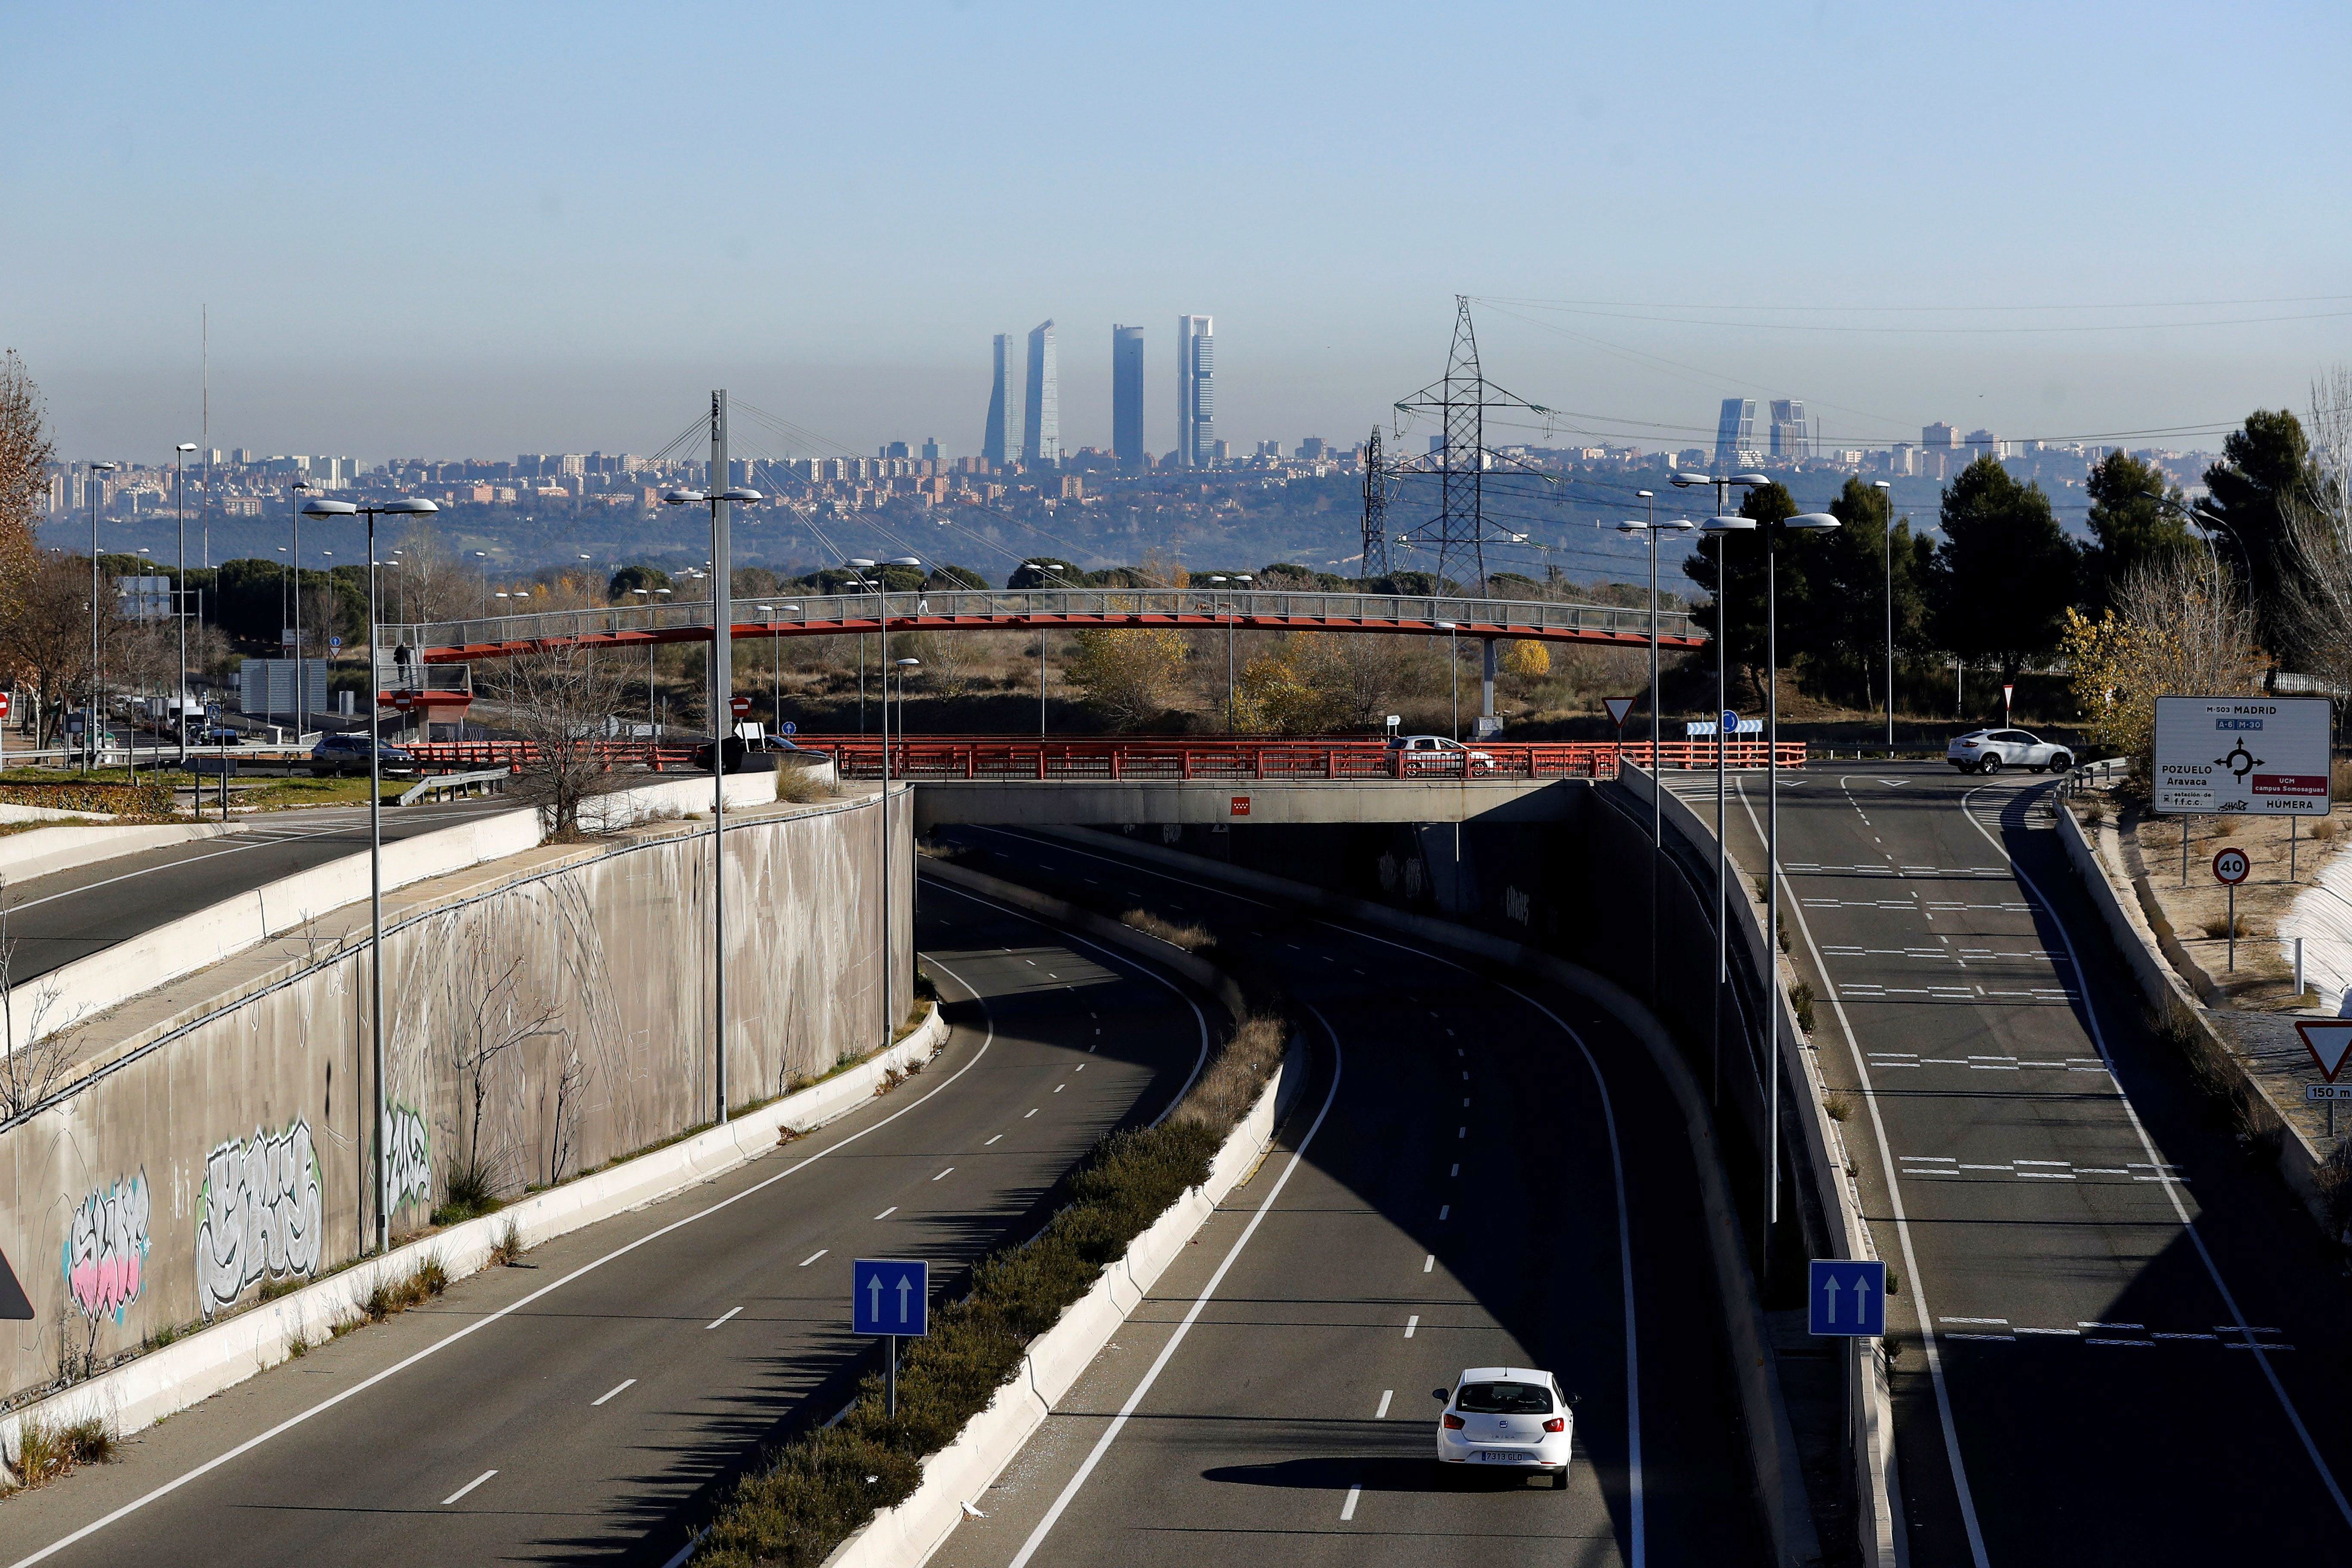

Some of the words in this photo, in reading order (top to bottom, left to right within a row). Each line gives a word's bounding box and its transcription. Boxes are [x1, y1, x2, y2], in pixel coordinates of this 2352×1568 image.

[2234, 706, 2277, 714] MADRID
[2162, 765, 2212, 774] POZUELO
[2167, 777, 2207, 785] Aravaca
[2267, 799, 2313, 809] HÚMERA
[2220, 860, 2243, 873] 40
[2312, 1087, 2334, 1097] 150
